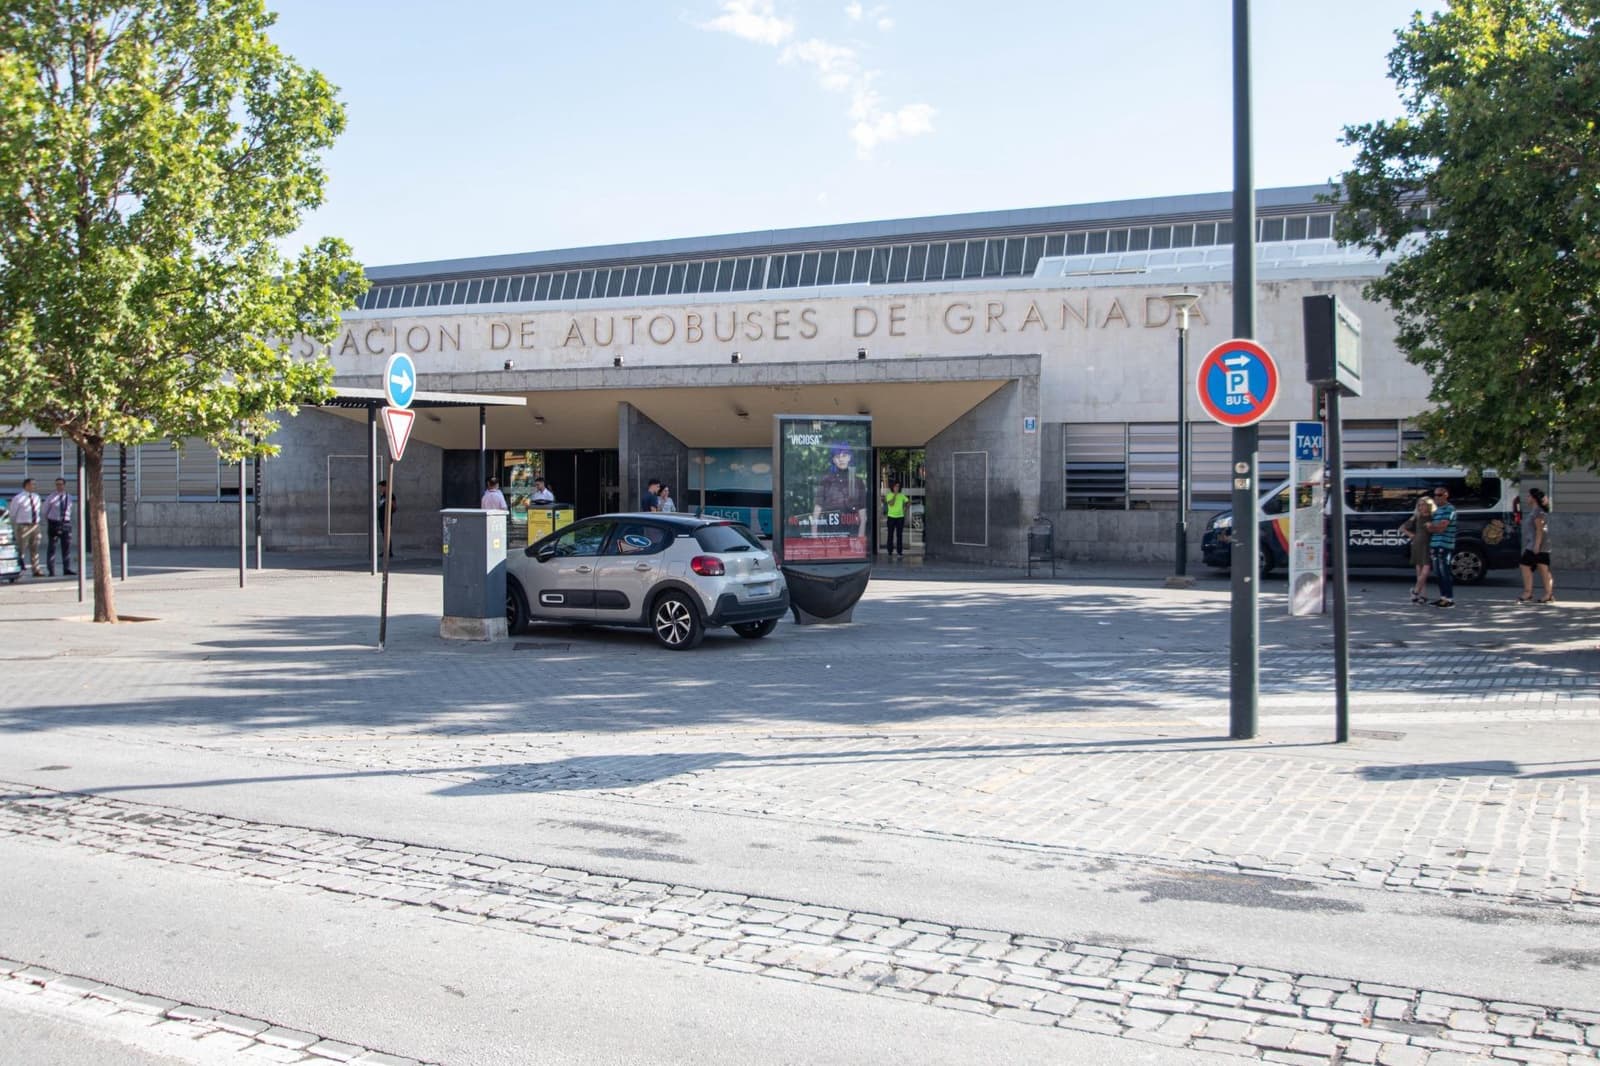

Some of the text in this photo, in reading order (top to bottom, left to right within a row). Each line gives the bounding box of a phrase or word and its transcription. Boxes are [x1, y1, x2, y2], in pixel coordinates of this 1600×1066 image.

[489, 320, 535, 350] DE
[563, 308, 818, 348] AUTOBUSES
[852, 304, 906, 338] DE
[1231, 373, 1244, 391] P
[1226, 394, 1250, 405] BUS
[1296, 434, 1322, 448] TAXI
